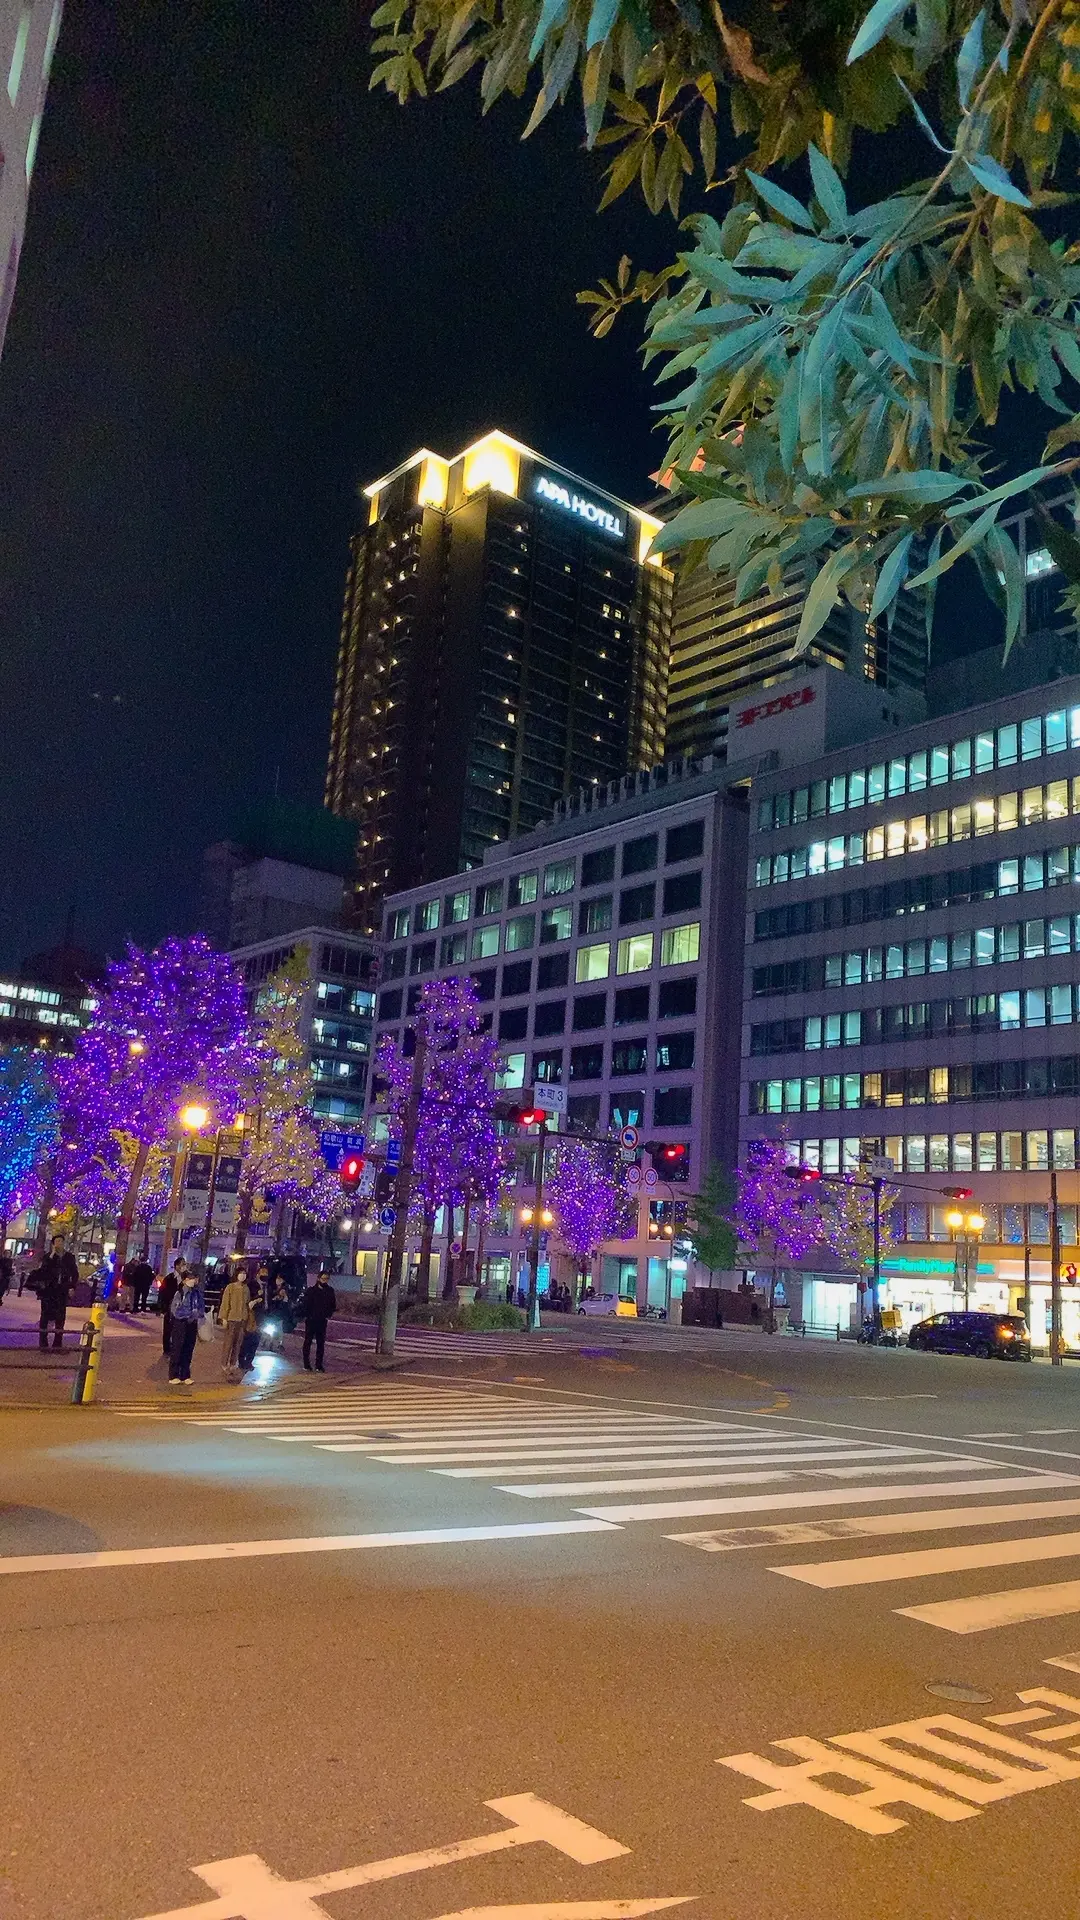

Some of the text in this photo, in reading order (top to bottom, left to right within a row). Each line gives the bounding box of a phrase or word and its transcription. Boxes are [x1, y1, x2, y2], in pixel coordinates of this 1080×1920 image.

[536, 477, 624, 537] APA HOTEL
[538, 1087, 564, 1102] 本町3
[899, 1256, 955, 1274] FamilyMart
